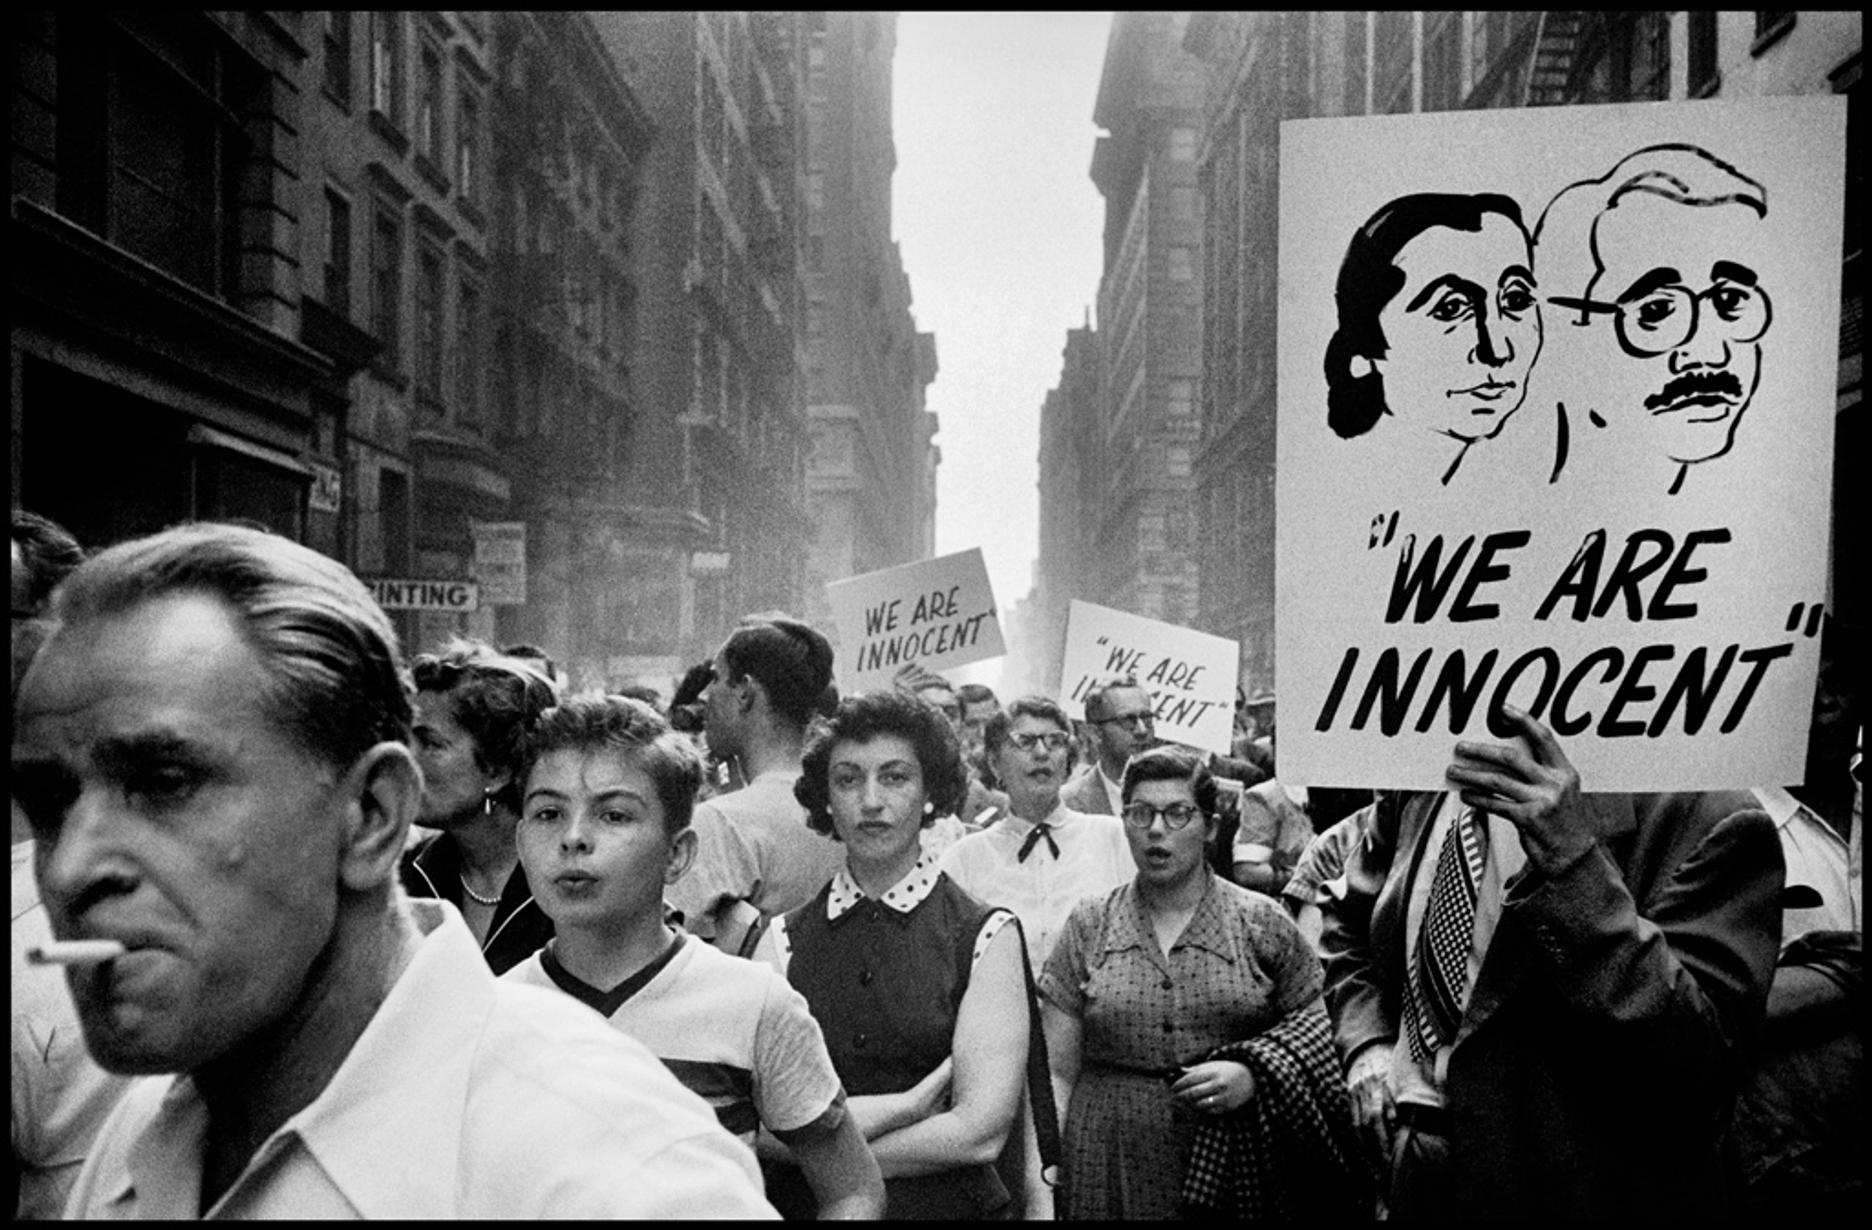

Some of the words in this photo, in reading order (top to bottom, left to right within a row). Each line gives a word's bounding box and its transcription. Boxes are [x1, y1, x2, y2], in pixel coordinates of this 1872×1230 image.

[366, 582, 469, 606] INTING
[1534, 528, 1732, 622] ARE
[866, 600, 902, 637] WE
[911, 585, 959, 626] ARE
[1147, 657, 1206, 691] ARE
[1314, 602, 1825, 738] INNOCENT"
